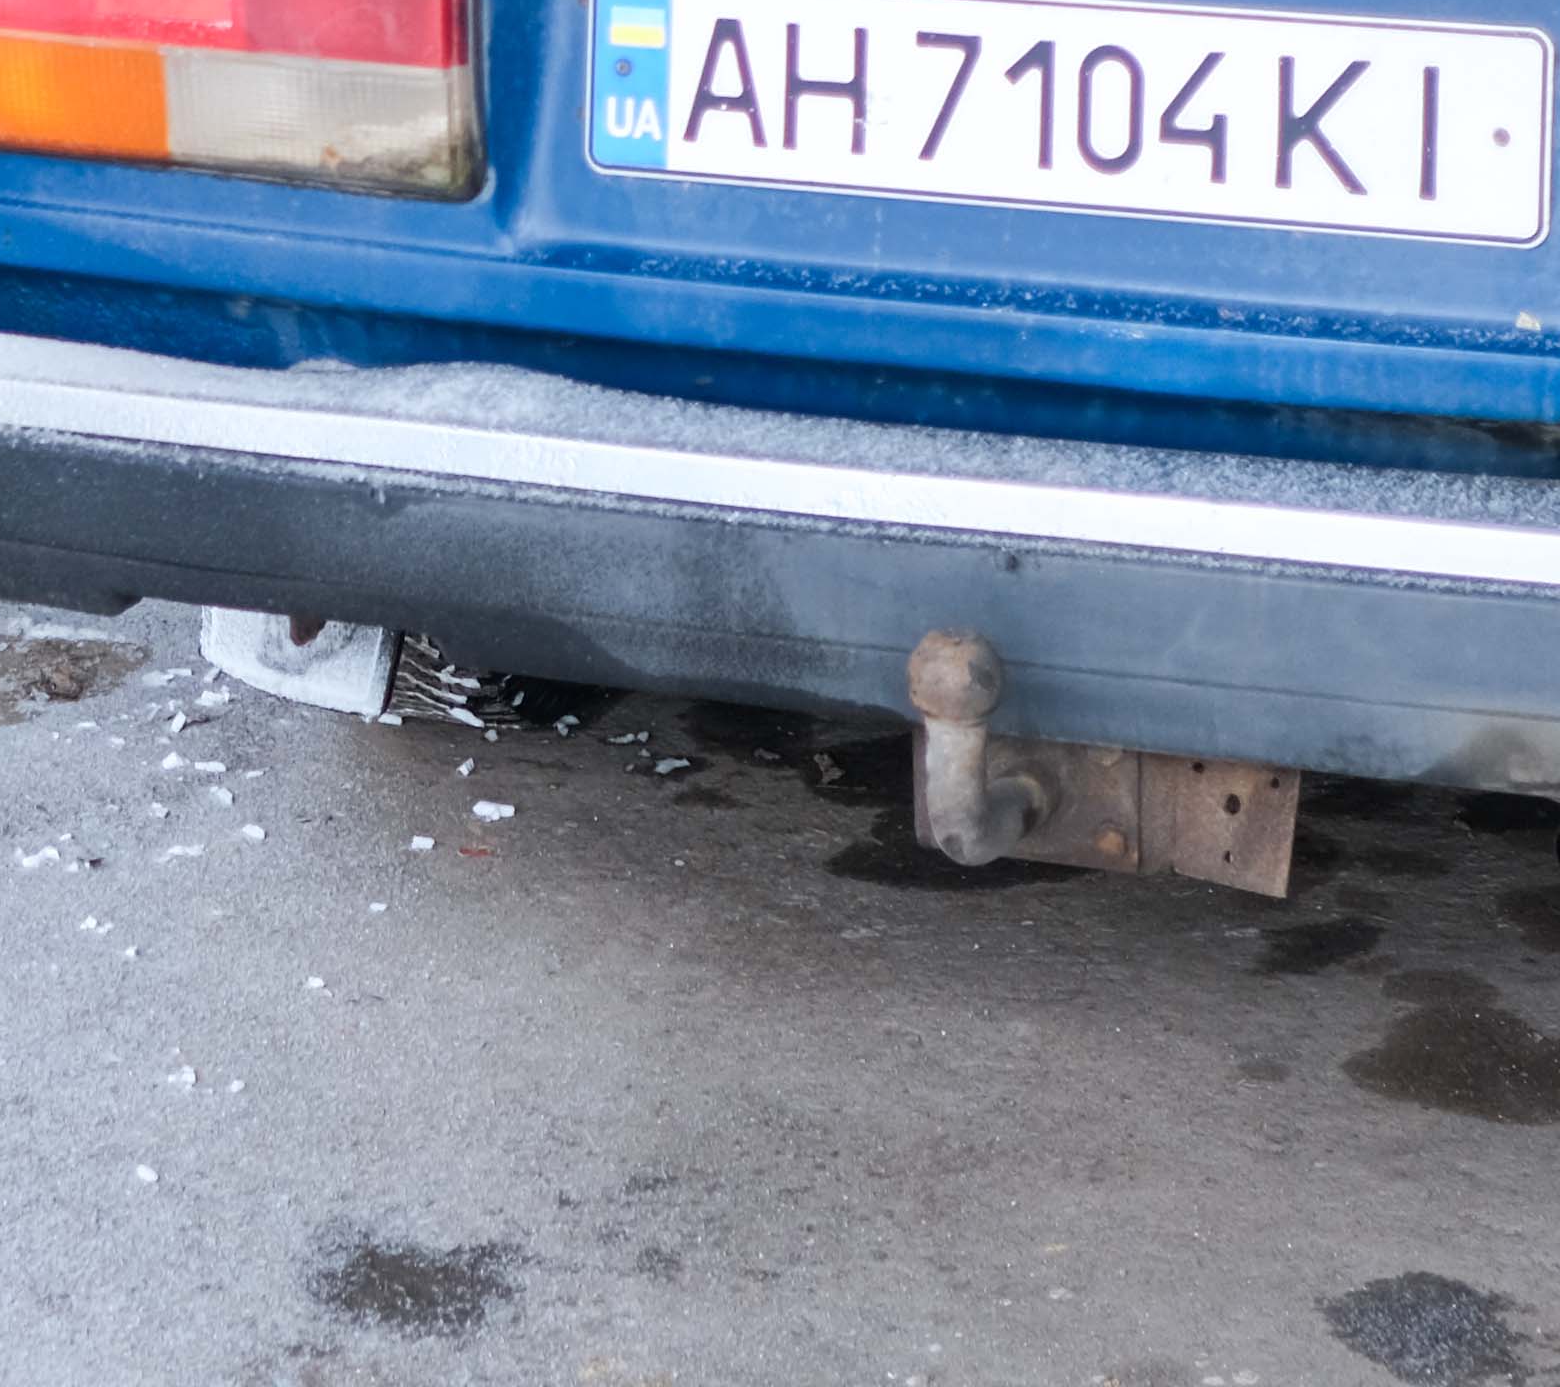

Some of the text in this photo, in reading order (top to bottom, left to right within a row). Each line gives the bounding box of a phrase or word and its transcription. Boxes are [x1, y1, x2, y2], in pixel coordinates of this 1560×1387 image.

[605, 95, 663, 141] UA
[683, 18, 1439, 201] AH 7104 KI
